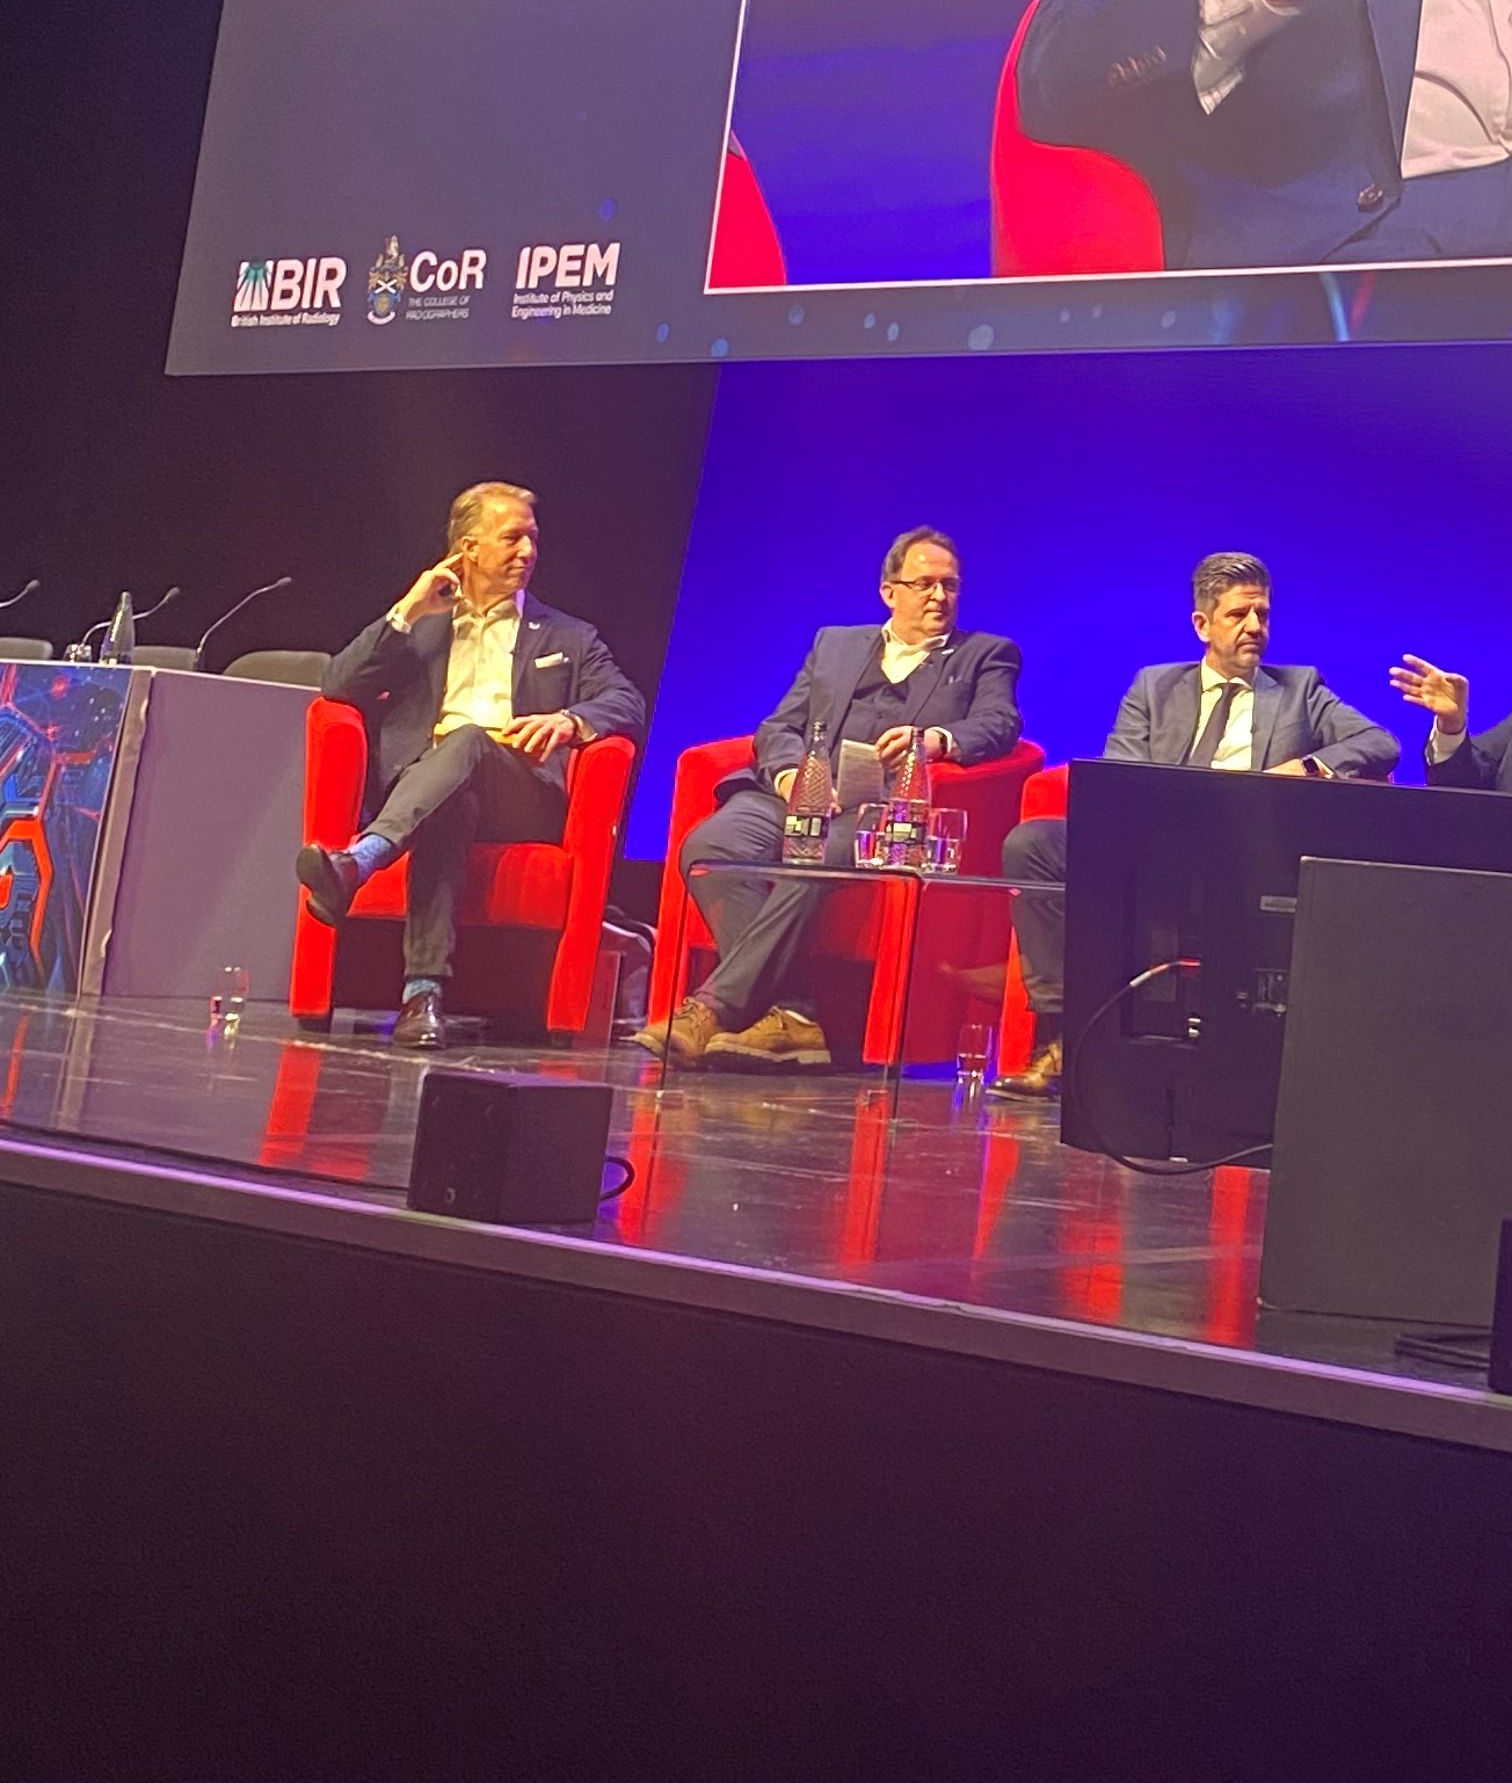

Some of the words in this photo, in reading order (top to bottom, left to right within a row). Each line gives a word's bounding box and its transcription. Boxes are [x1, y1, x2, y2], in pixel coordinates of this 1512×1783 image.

[270, 257, 347, 310] BIR
[410, 249, 487, 293] CoR
[516, 243, 620, 289] IPEM
[595, 290, 614, 302] and
